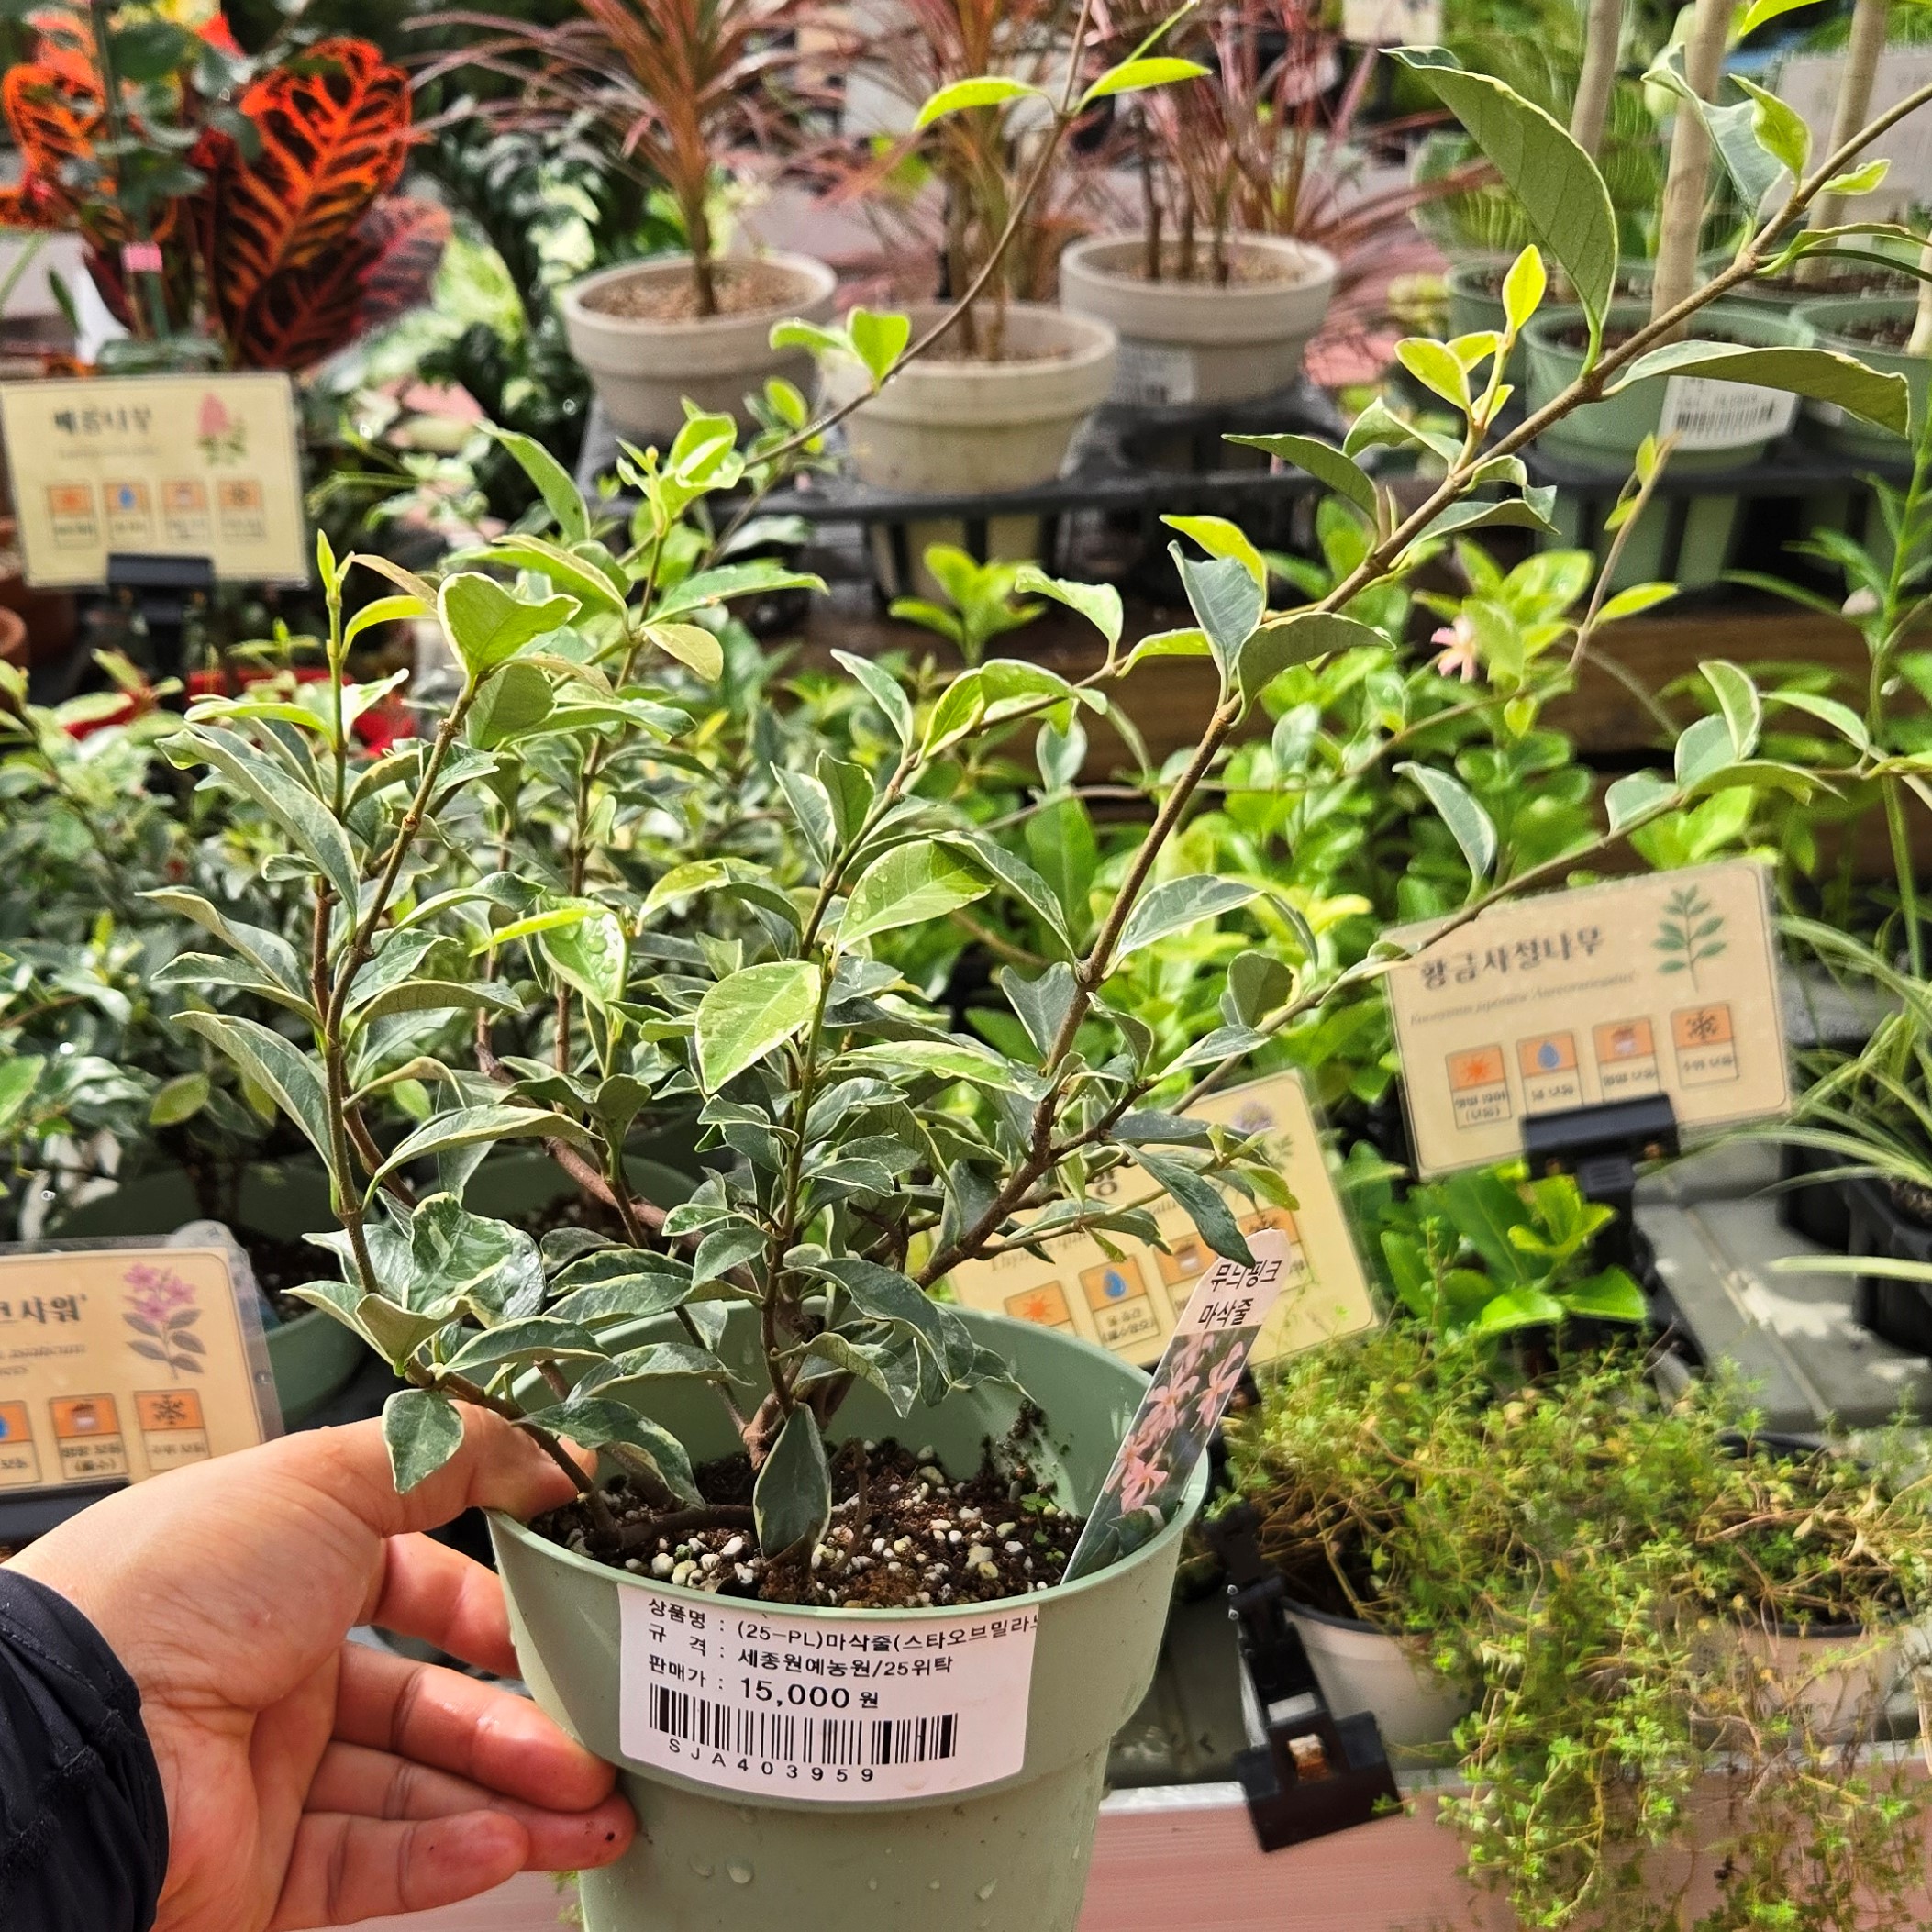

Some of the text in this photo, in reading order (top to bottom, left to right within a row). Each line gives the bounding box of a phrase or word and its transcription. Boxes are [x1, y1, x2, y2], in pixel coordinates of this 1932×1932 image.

[1210, 1259, 1283, 1293] 무늬핑크
[1197, 1297, 1255, 1330] 마삭줄
[648, 1598, 706, 1630] 상품명
[738, 1649, 954, 1678] 세종원예농원/25위탁
[649, 1653, 707, 1688] 판매가
[740, 1677, 850, 1708] 15,000
[859, 1691, 879, 1709] 원
[668, 1738, 874, 1782] SJA403959
